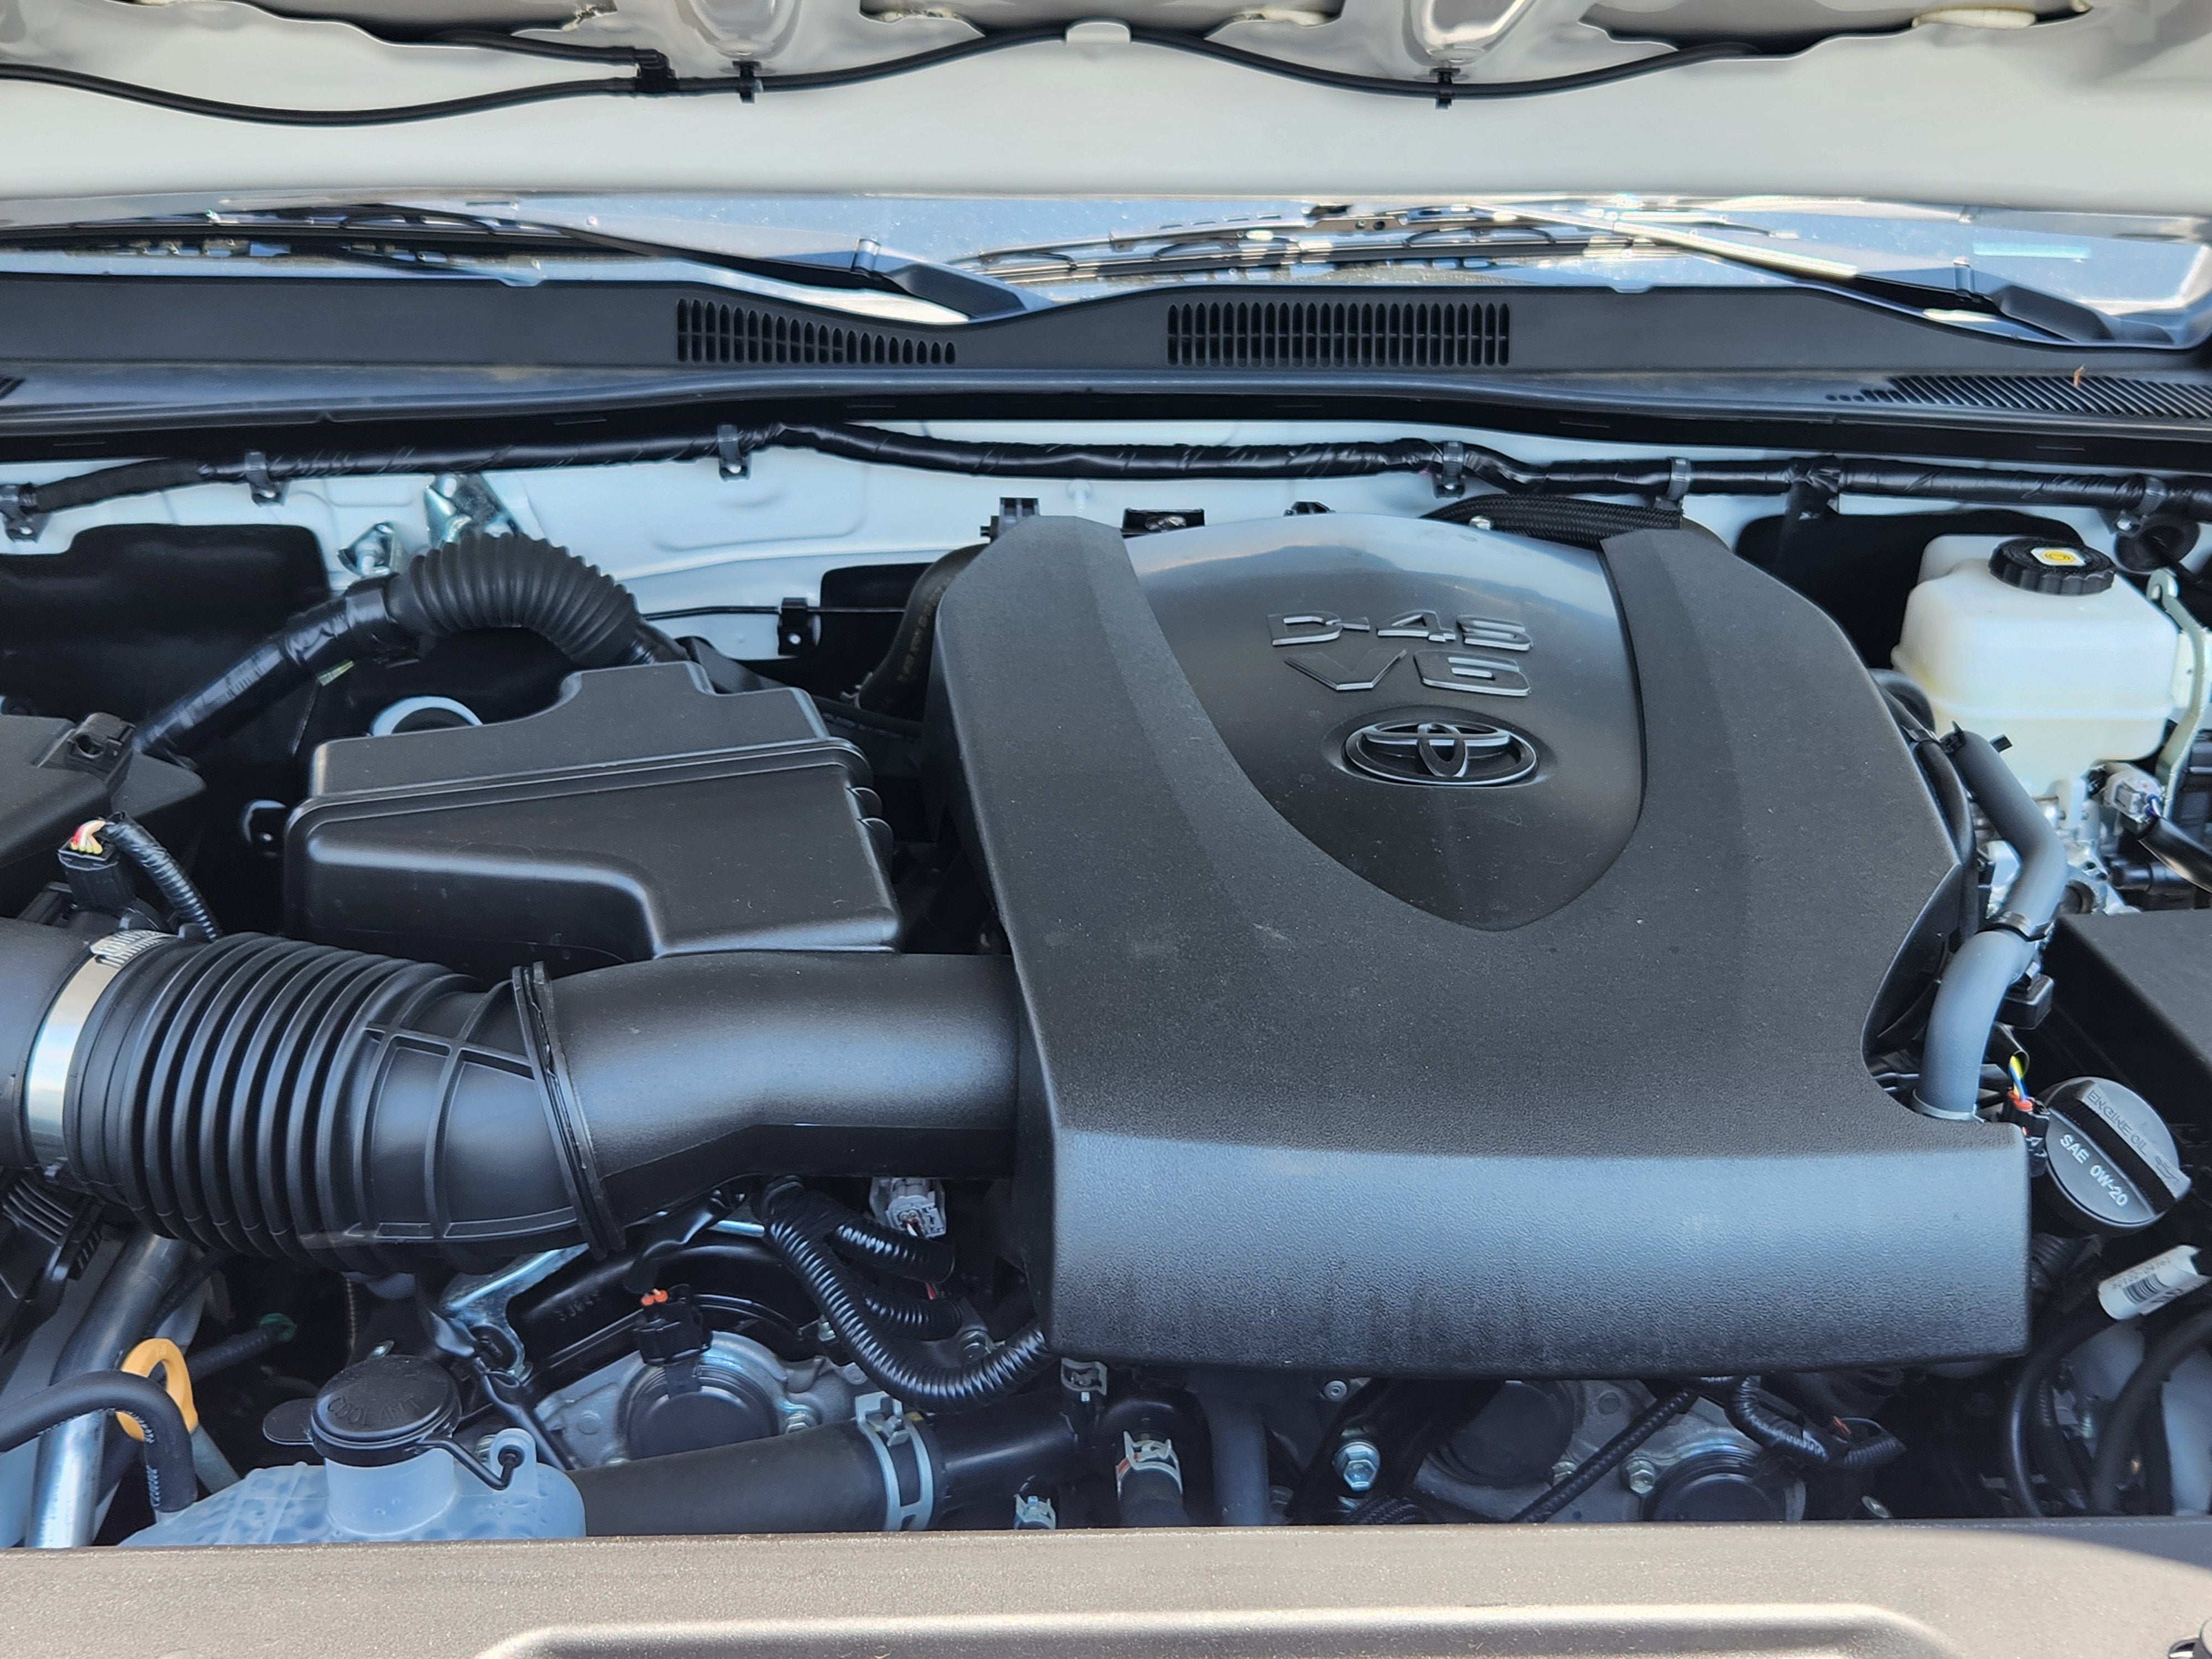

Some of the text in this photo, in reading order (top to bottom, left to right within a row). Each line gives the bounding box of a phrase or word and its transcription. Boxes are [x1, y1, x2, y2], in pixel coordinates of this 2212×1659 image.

[1267, 610, 1533, 651] D-4S
[1284, 649, 1531, 696] V6
[2087, 1089, 2148, 1156] ENGINE OIL
[2060, 1134, 2128, 1206] SAE 0W-20
[327, 1394, 420, 1426] COOLANT
